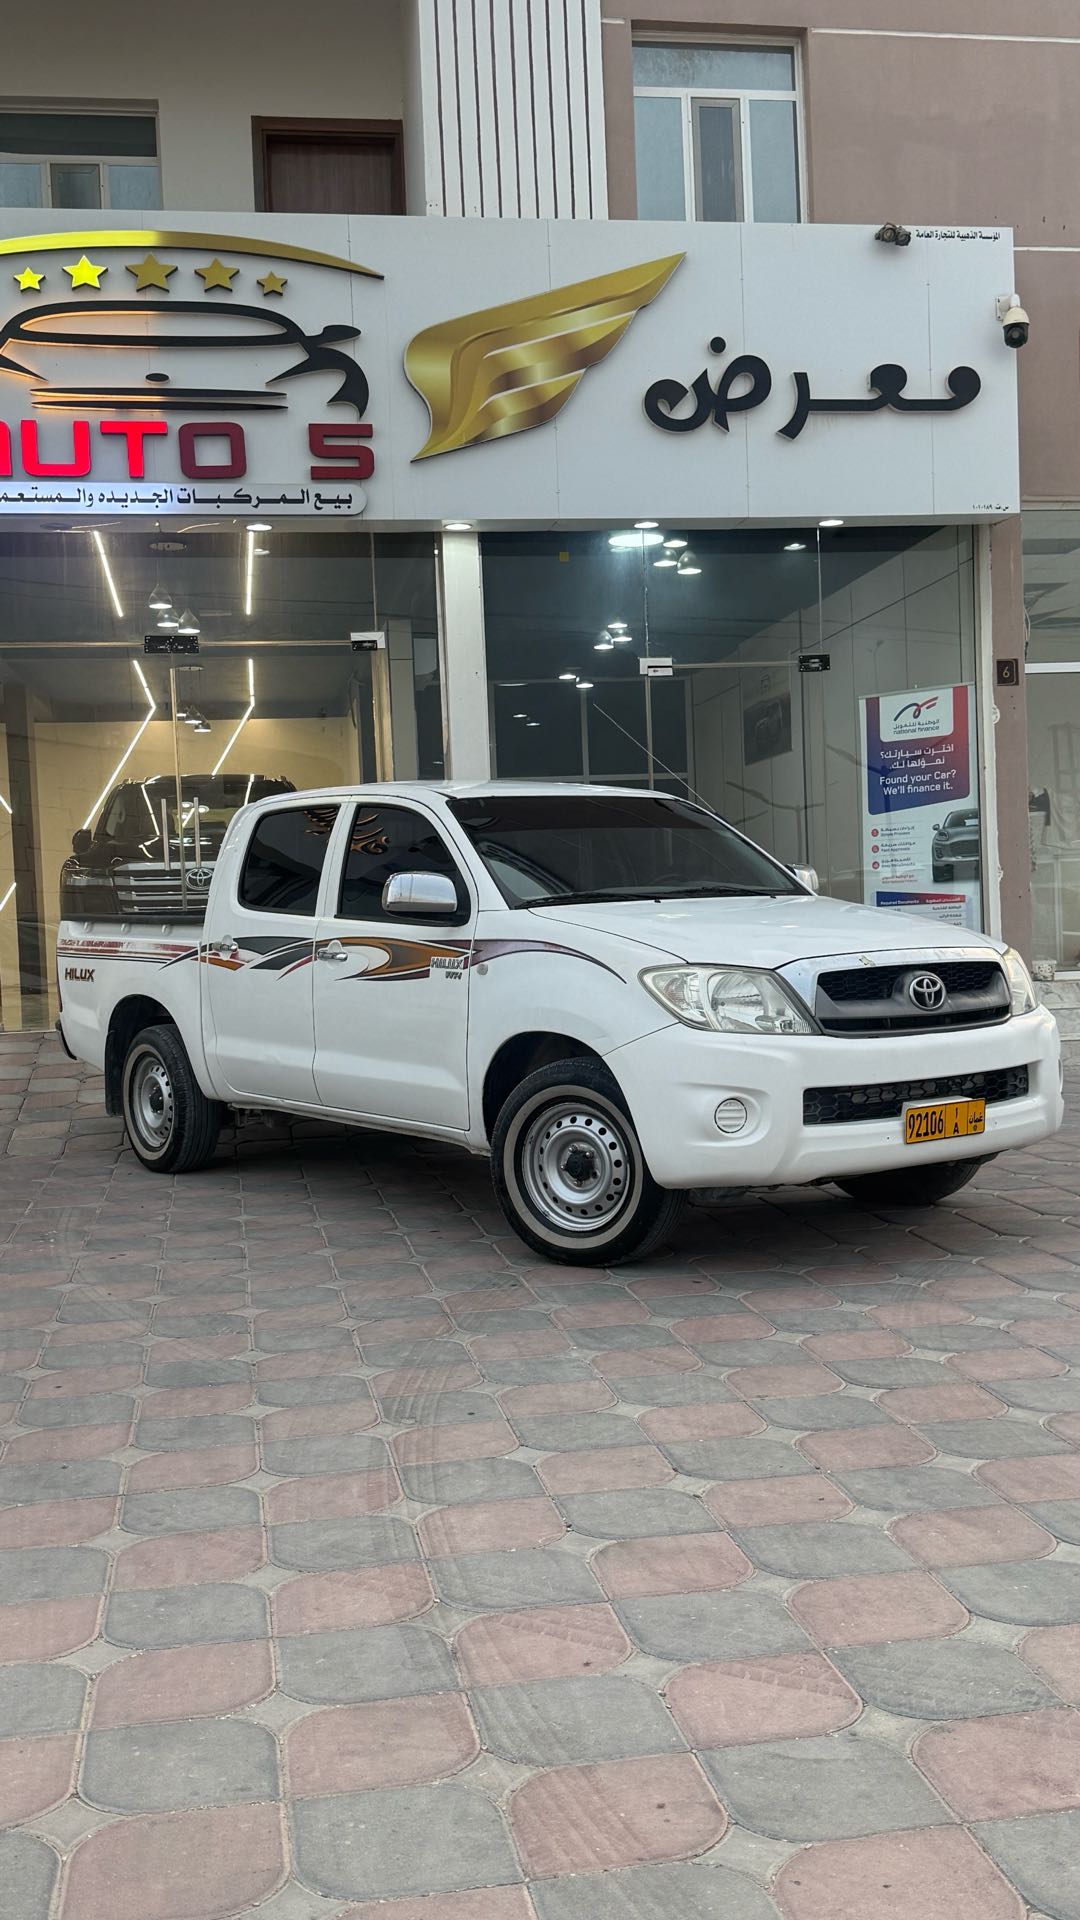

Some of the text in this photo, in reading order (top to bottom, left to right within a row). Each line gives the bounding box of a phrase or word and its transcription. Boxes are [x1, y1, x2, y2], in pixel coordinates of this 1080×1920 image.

[644, 336, 981, 440] معرض
[0, 418, 247, 480] UTO
[0, 486, 353, 511] بيع المركبات الجديده والمستعم
[1002, 666, 1010, 678] 6
[893, 727, 917, 735] national
[880, 743, 954, 760] اخترت سيارتك؟
[879, 769, 957, 785] Found your Car?
[883, 781, 954, 796] We'll finance it.
[430, 957, 464, 970] HILUX
[65, 967, 96, 983] HILUX
[908, 1109, 944, 1139] 92106
[953, 1122, 960, 1134] A
